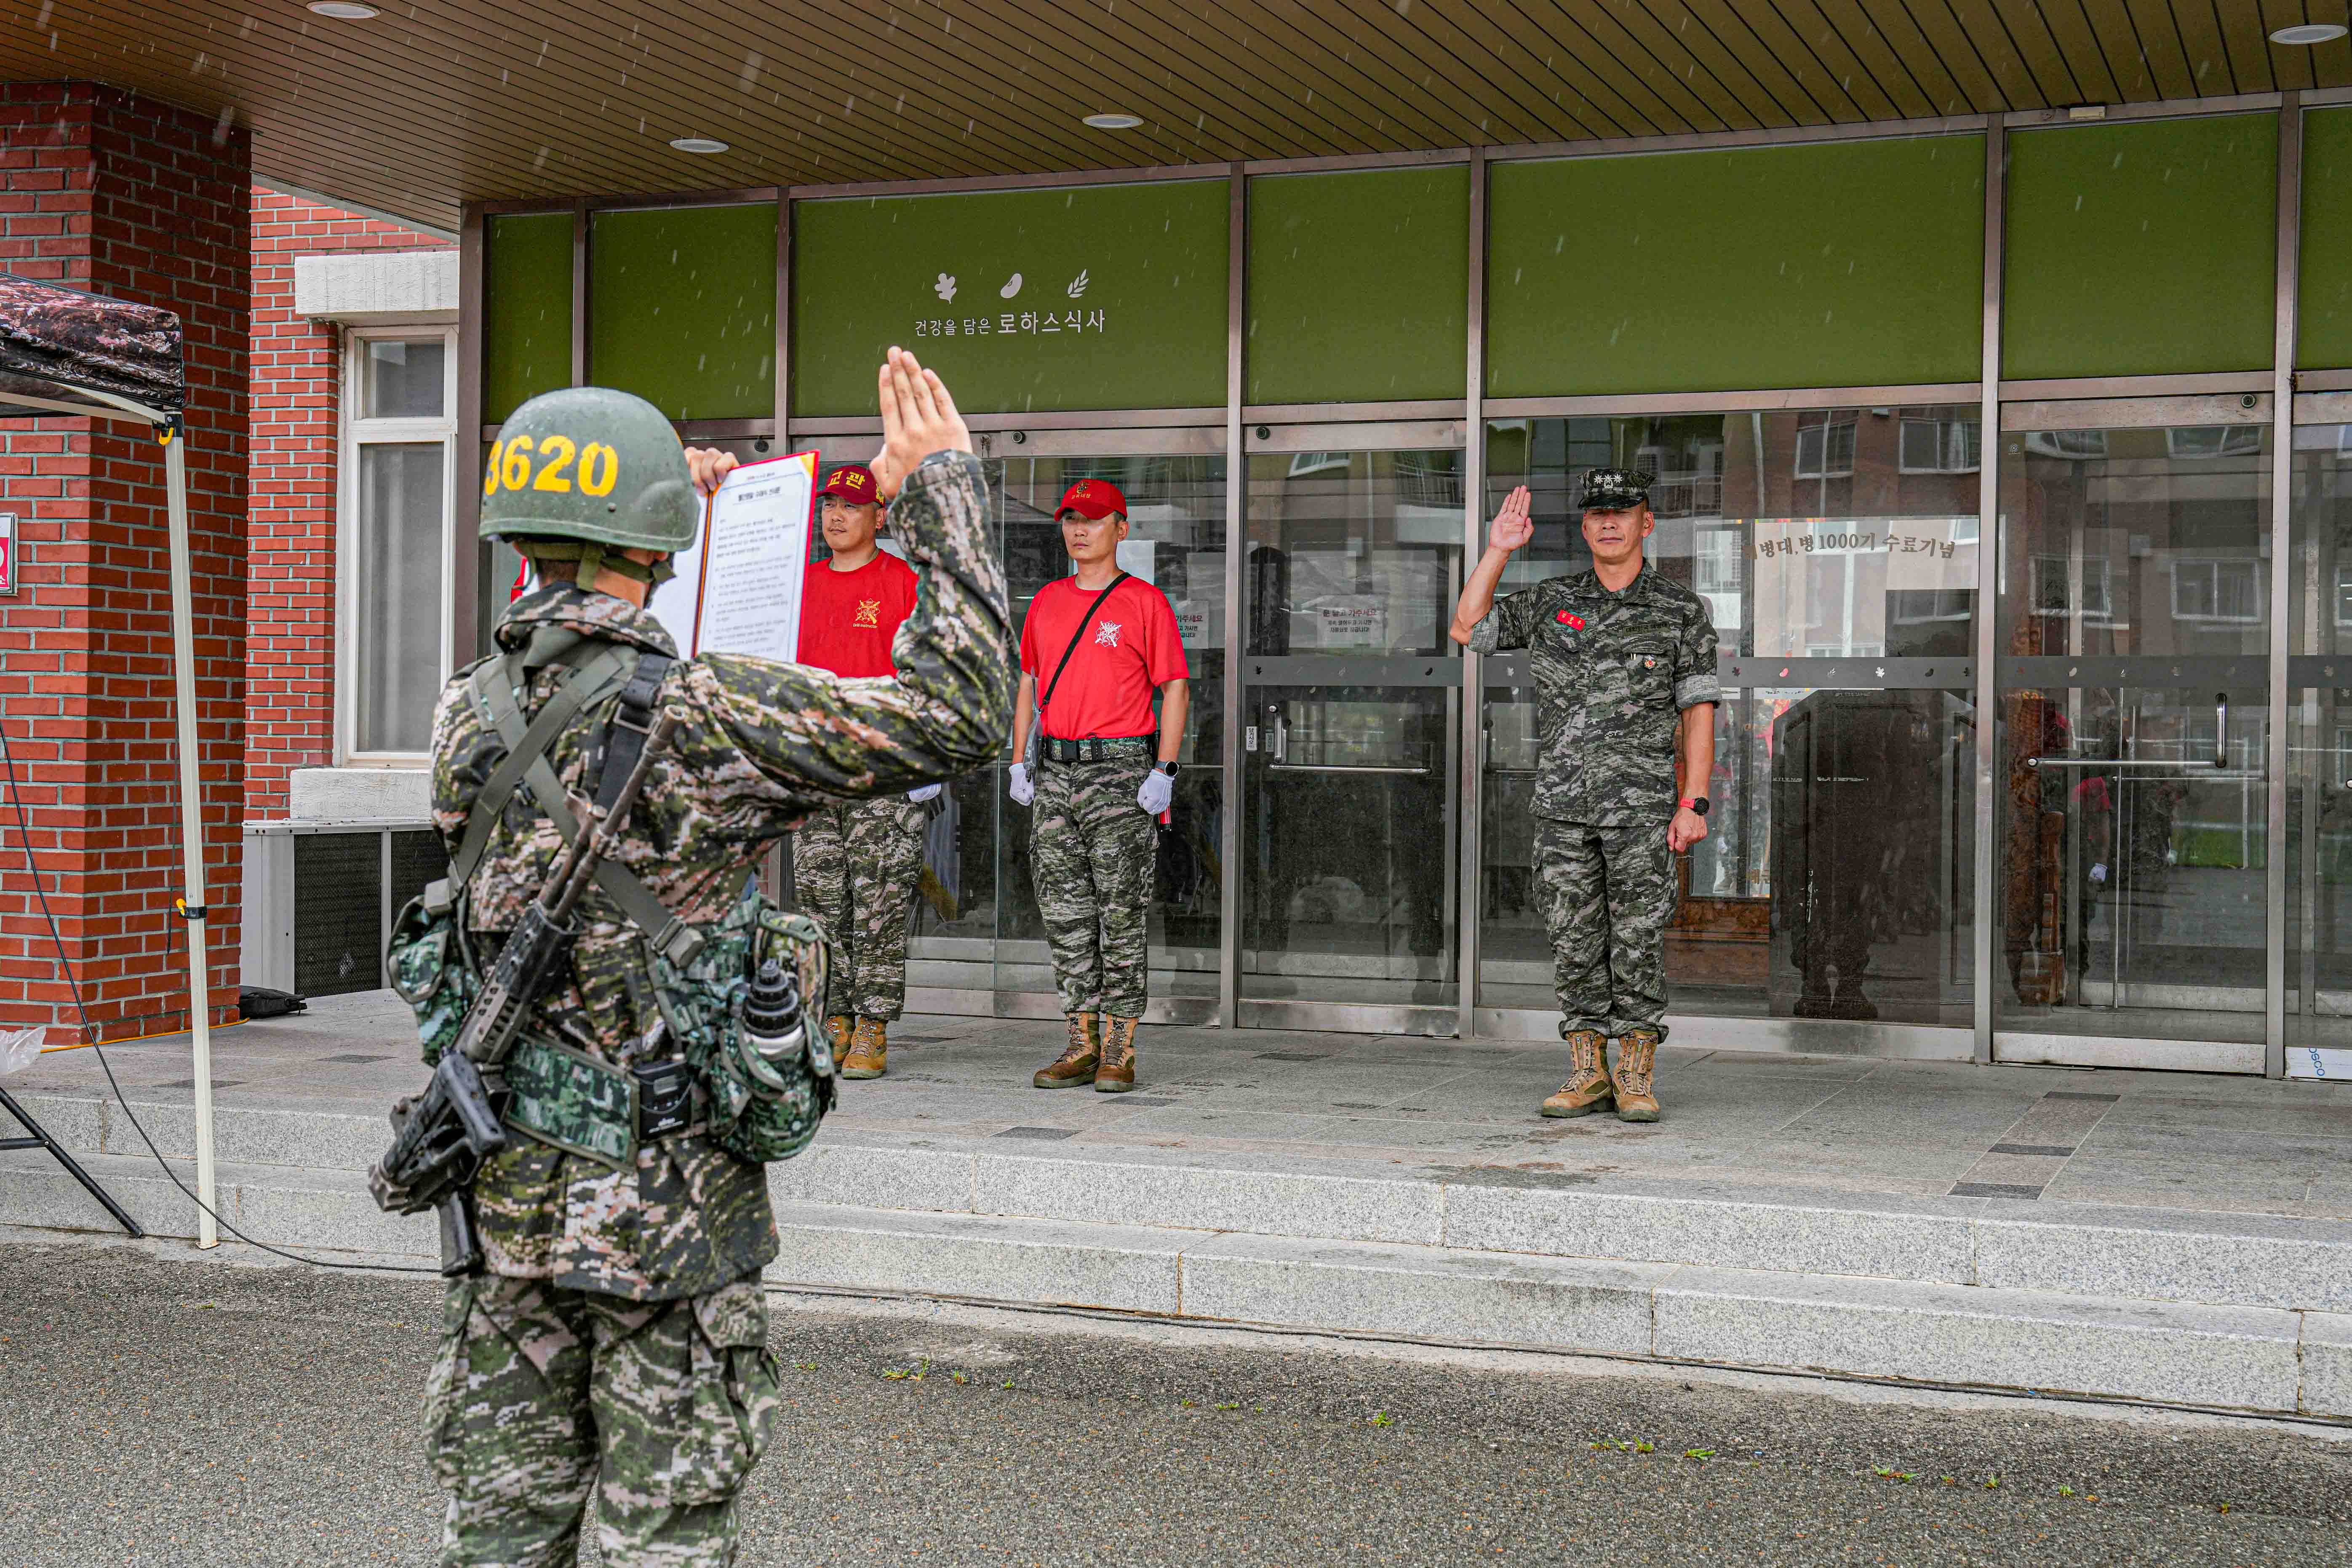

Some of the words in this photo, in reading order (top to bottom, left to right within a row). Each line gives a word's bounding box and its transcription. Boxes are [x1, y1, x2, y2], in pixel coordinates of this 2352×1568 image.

[915, 319, 957, 337] 건강을
[963, 317, 991, 335] 담은
[998, 309, 1105, 335] 로하스식사
[1881, 534, 1955, 558] 수료기념
